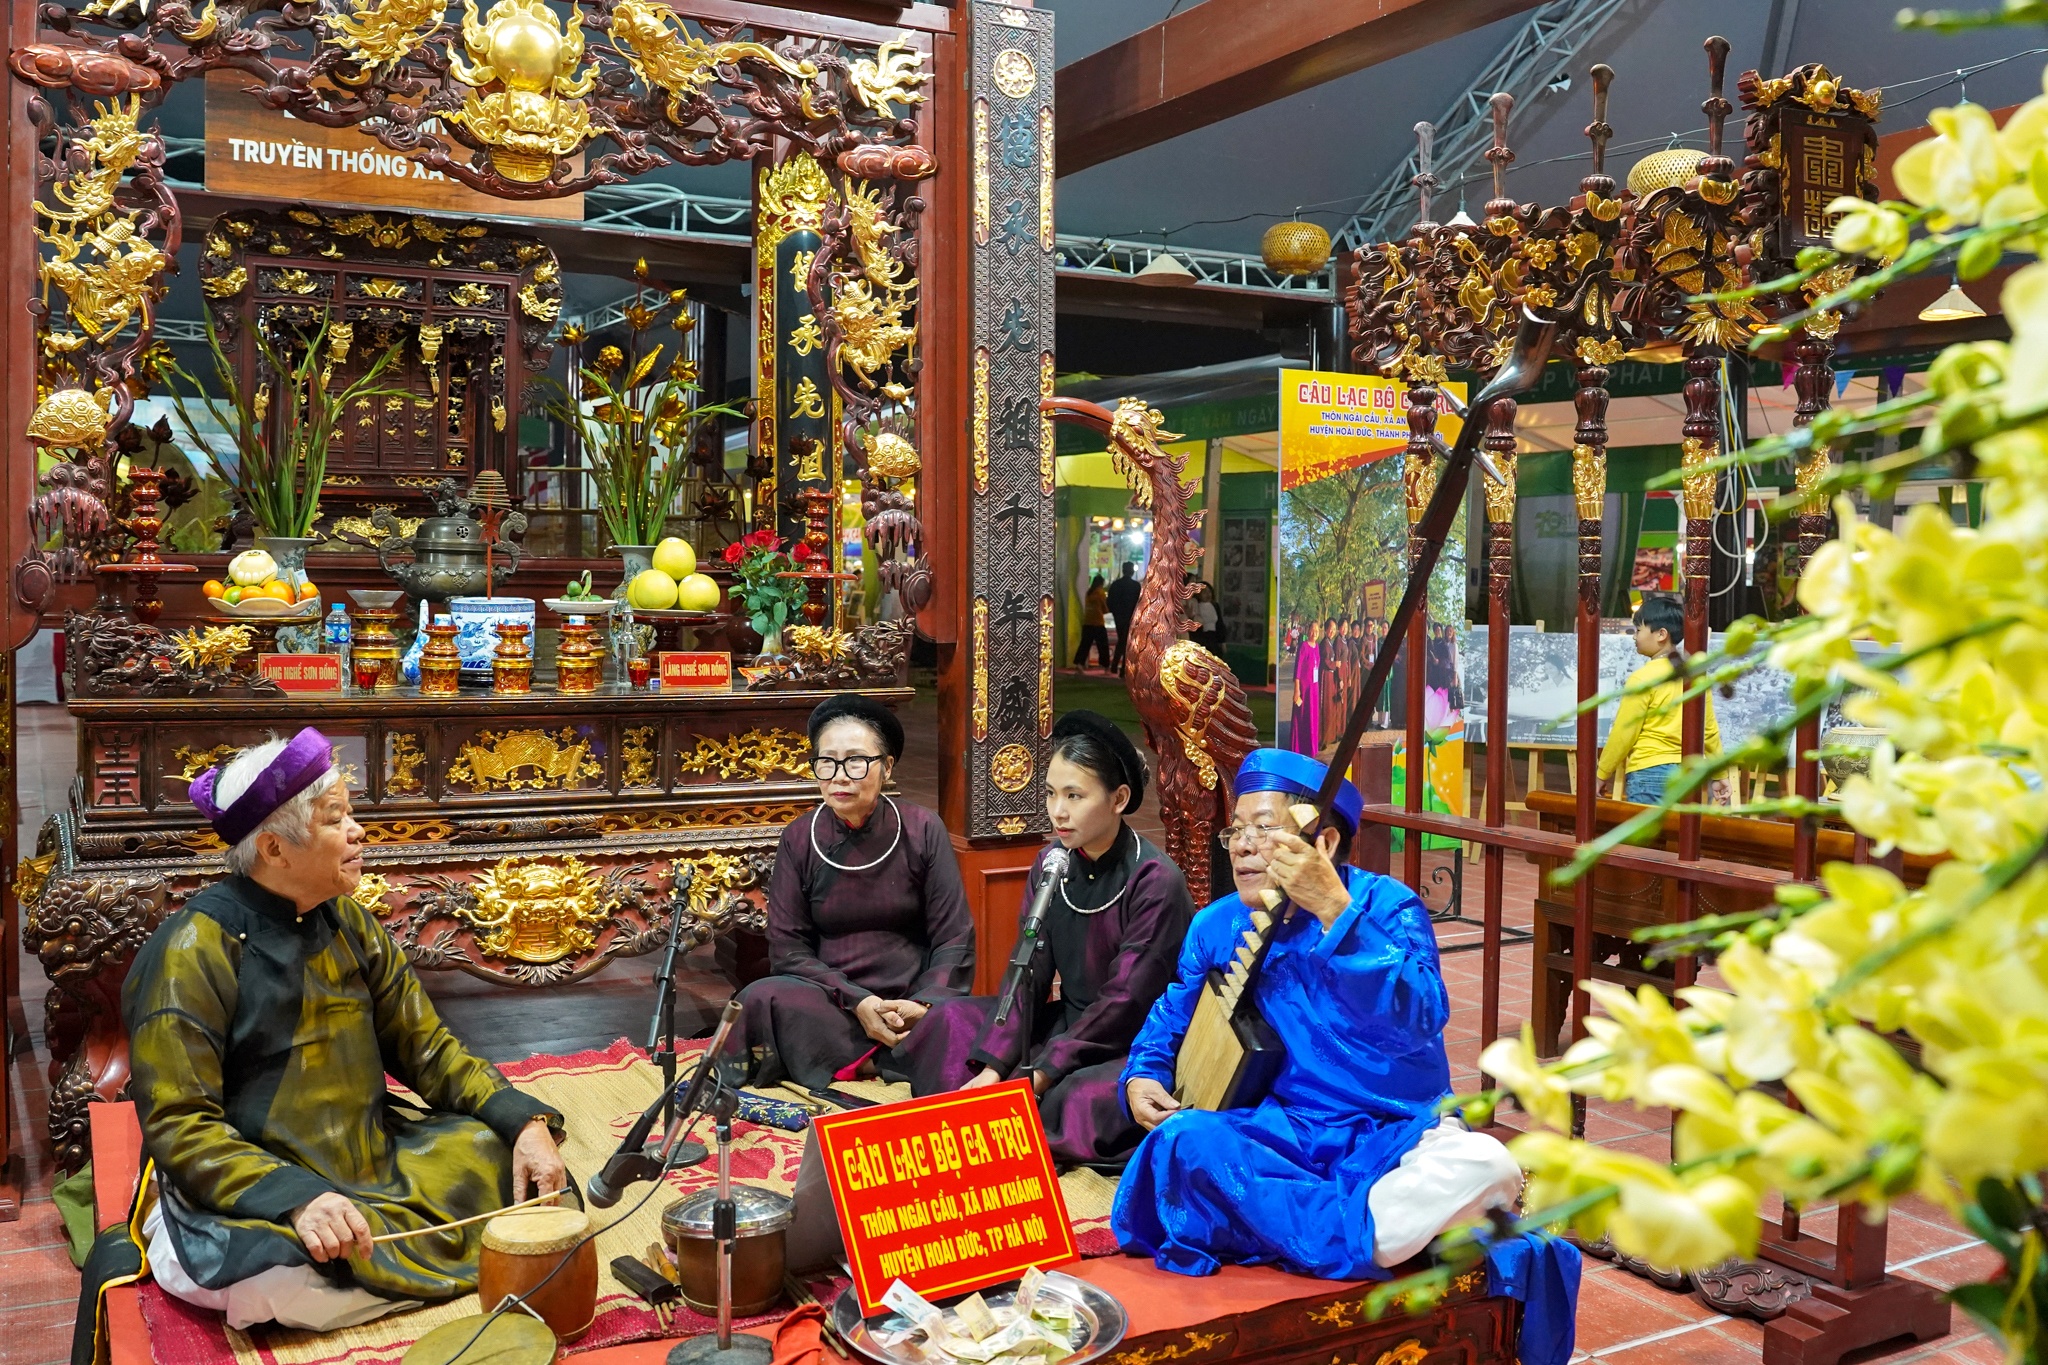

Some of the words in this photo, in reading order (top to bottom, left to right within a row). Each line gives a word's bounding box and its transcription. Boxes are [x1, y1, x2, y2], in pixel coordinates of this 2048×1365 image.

[228, 139, 323, 169] TRUYỀN
[327, 147, 407, 178] THỐNG
[1299, 380, 1331, 404] CÂU
[1337, 387, 1368, 410] LẠC
[1373, 386, 1395, 412] BỘ
[1310, 424, 1334, 437] HUYỆN
[1335, 426, 1355, 436] HOÀI
[1376, 428, 1400, 438] THÀNH
[1401, 431, 1411, 439] PH
[1321, 411, 1342, 421] THÔN
[1396, 416, 1406, 425] AN
[264, 663, 283, 680] LÀNG
[303, 666, 318, 680] SƠN
[664, 661, 680, 677] LÀNG
[697, 663, 710, 677] SƠN
[843, 1137, 889, 1191] CÂU
[886, 1135, 931, 1188] LẠC
[928, 1120, 963, 1180] BỘ
[960, 1123, 993, 1166] CA
[988, 1107, 1033, 1161] TRÙ
[860, 1205, 898, 1239] THÔN
[896, 1198, 931, 1231] NGÃI
[930, 1189, 964, 1223] CẦU,
[960, 1186, 983, 1216] XÃ
[981, 1185, 1002, 1212] AN
[1001, 1175, 1044, 1208] KHÁNH
[878, 1243, 926, 1279] HUYỆN
[923, 1233, 957, 1268] HOÀI
[955, 1228, 989, 1261] ĐỨC,
[986, 1226, 1005, 1252] TP
[1004, 1218, 1026, 1249] HÀ
[1022, 1213, 1048, 1247] NỘI
